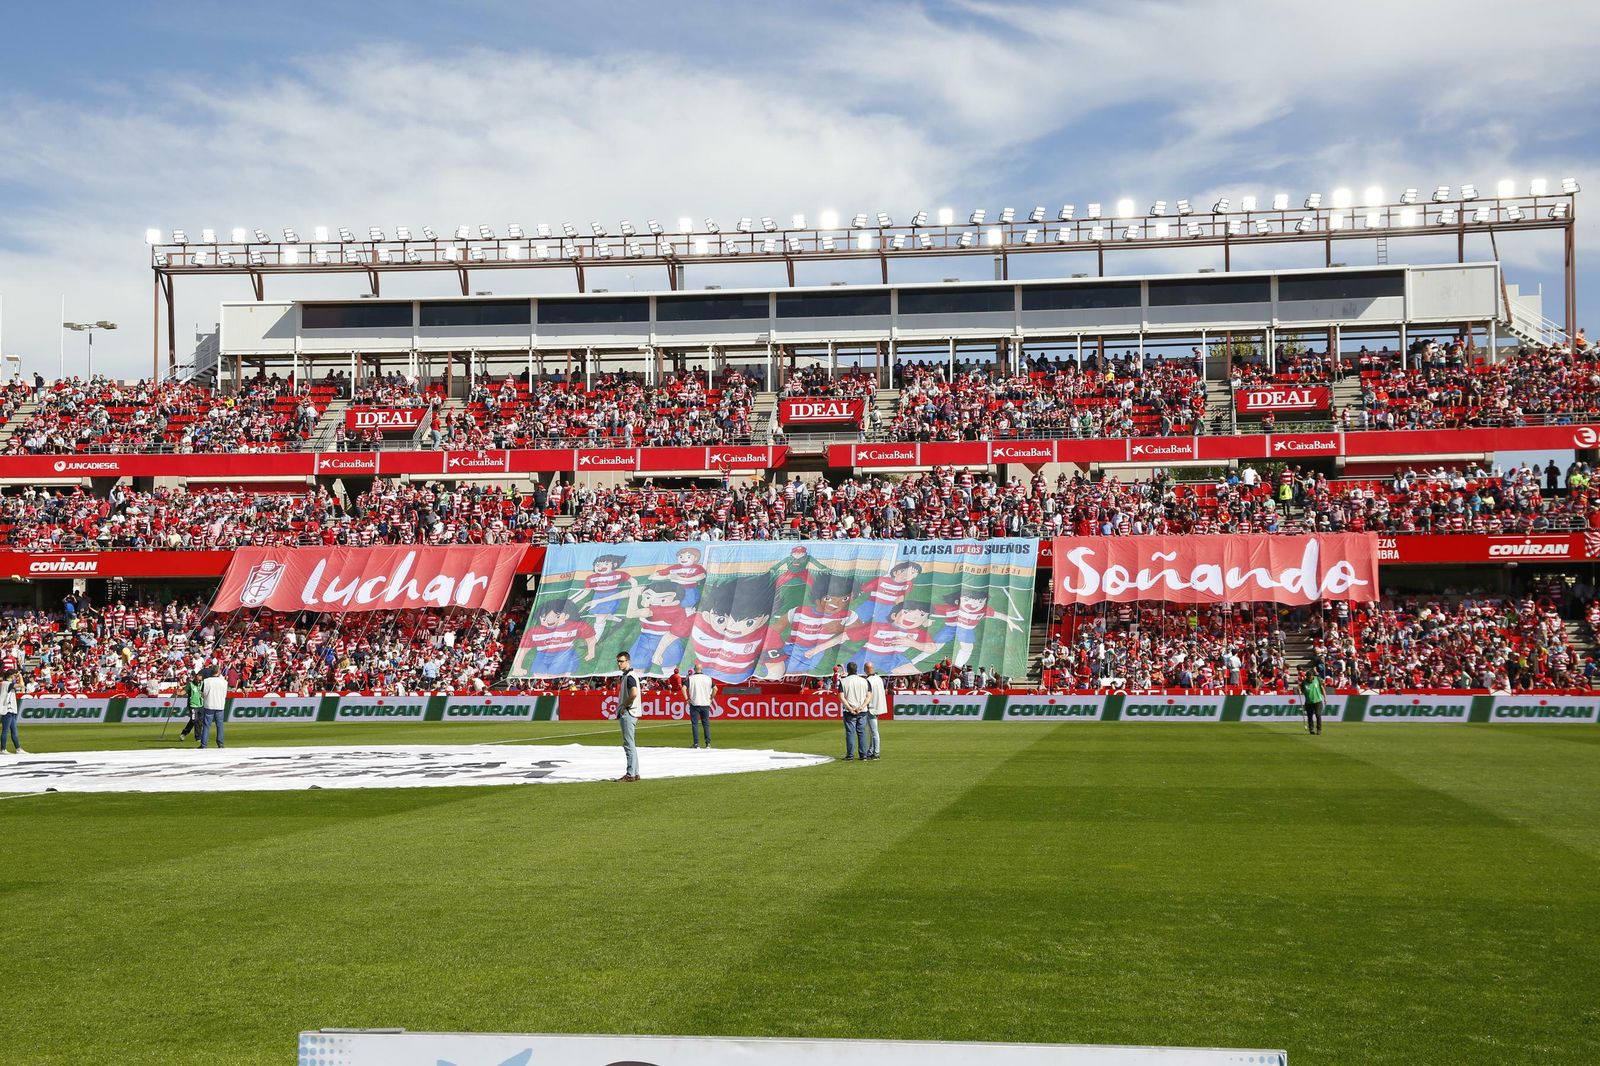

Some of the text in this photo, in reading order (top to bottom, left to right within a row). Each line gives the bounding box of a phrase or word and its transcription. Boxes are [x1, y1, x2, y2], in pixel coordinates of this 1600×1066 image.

[1247, 390, 1317, 406] IDEAL
[789, 403, 854, 417] IDEAL
[356, 411, 418, 425] IDEAL
[1145, 444, 1193, 454] CaixaBank
[1287, 441, 1337, 450] CaixaBank
[869, 450, 915, 459] CaixaBank
[1006, 447, 1052, 457] CaixaBank
[461, 457, 505, 467] CaixaBank
[591, 455, 635, 465] CaixaBank
[723, 453, 767, 463] CaixaBank
[66, 462, 119, 470] JUNCADIESEL
[331, 459, 375, 468] CaixaBank
[903, 545, 917, 555] LA
[921, 544, 952, 555] CASA
[967, 546, 981, 554] LOS
[984, 542, 1030, 555] SUEÑOS
[1063, 537, 1369, 600] Soñando
